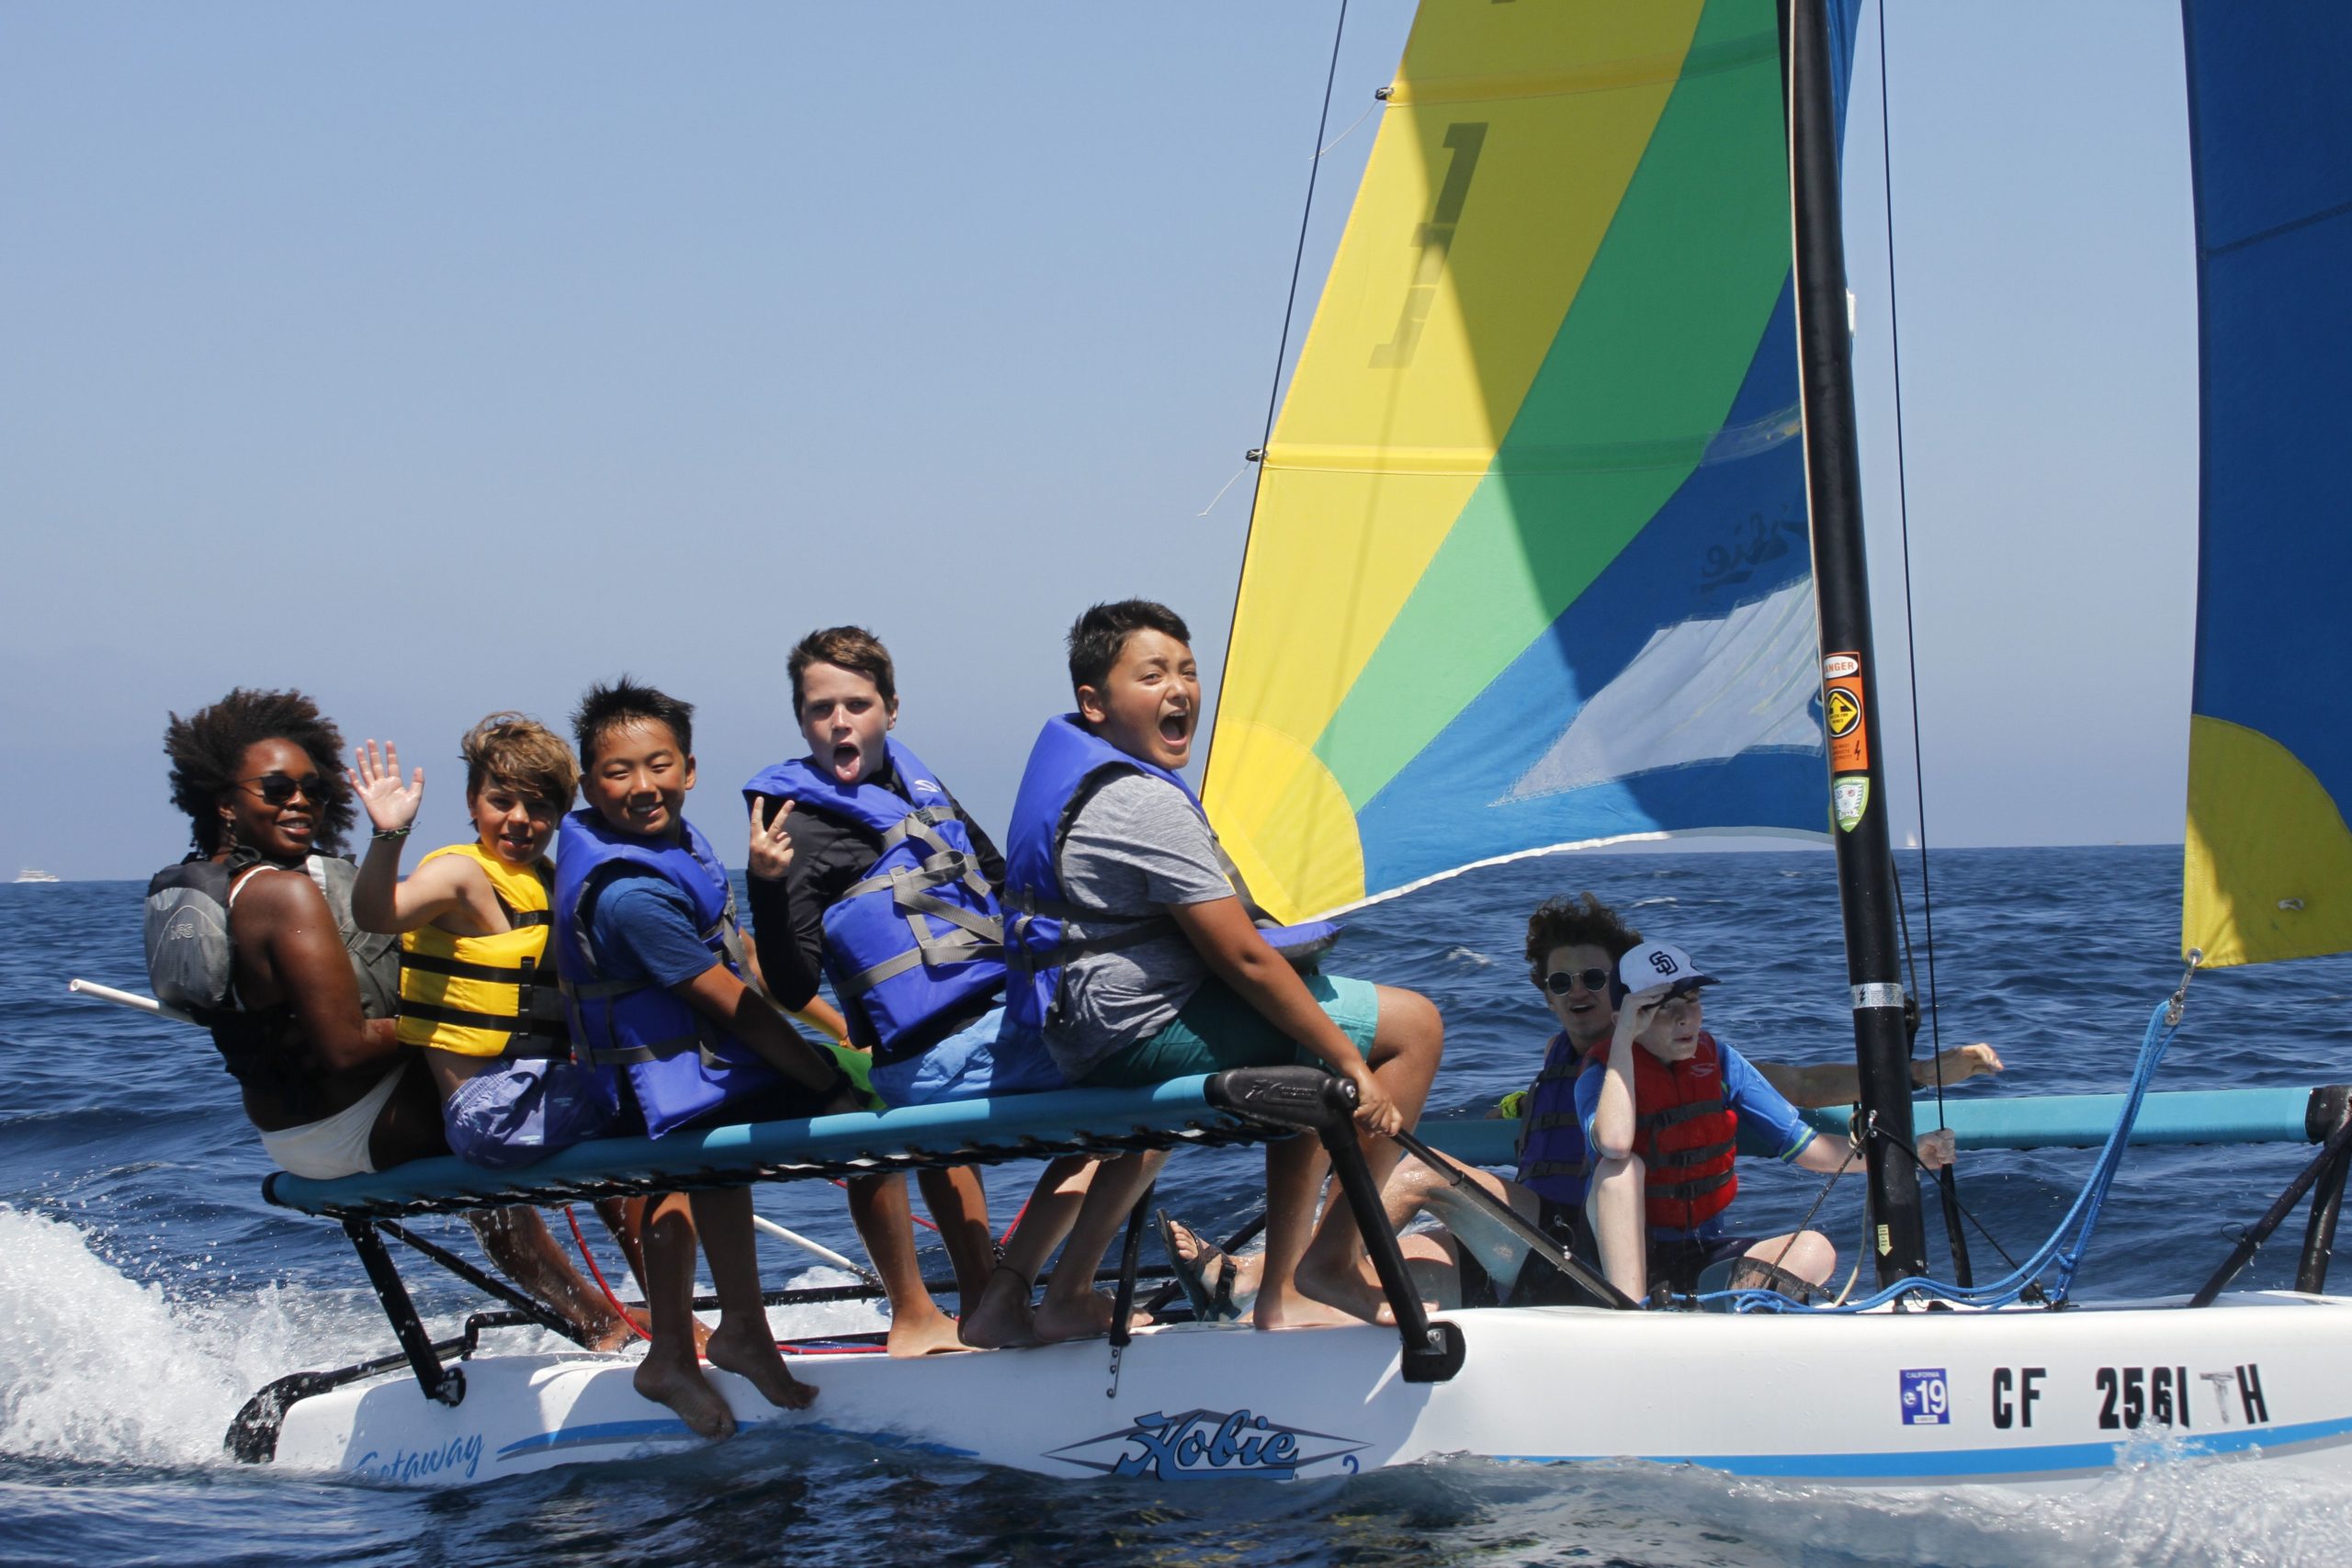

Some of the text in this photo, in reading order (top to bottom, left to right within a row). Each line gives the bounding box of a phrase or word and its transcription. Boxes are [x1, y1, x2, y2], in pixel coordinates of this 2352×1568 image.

[171, 923, 195, 941] NRS
[1649, 951, 1679, 976] SD
[1916, 1379, 1947, 1414] 19
[1992, 1367, 2047, 1429] CF
[1111, 1409, 1300, 1482] Hobie
